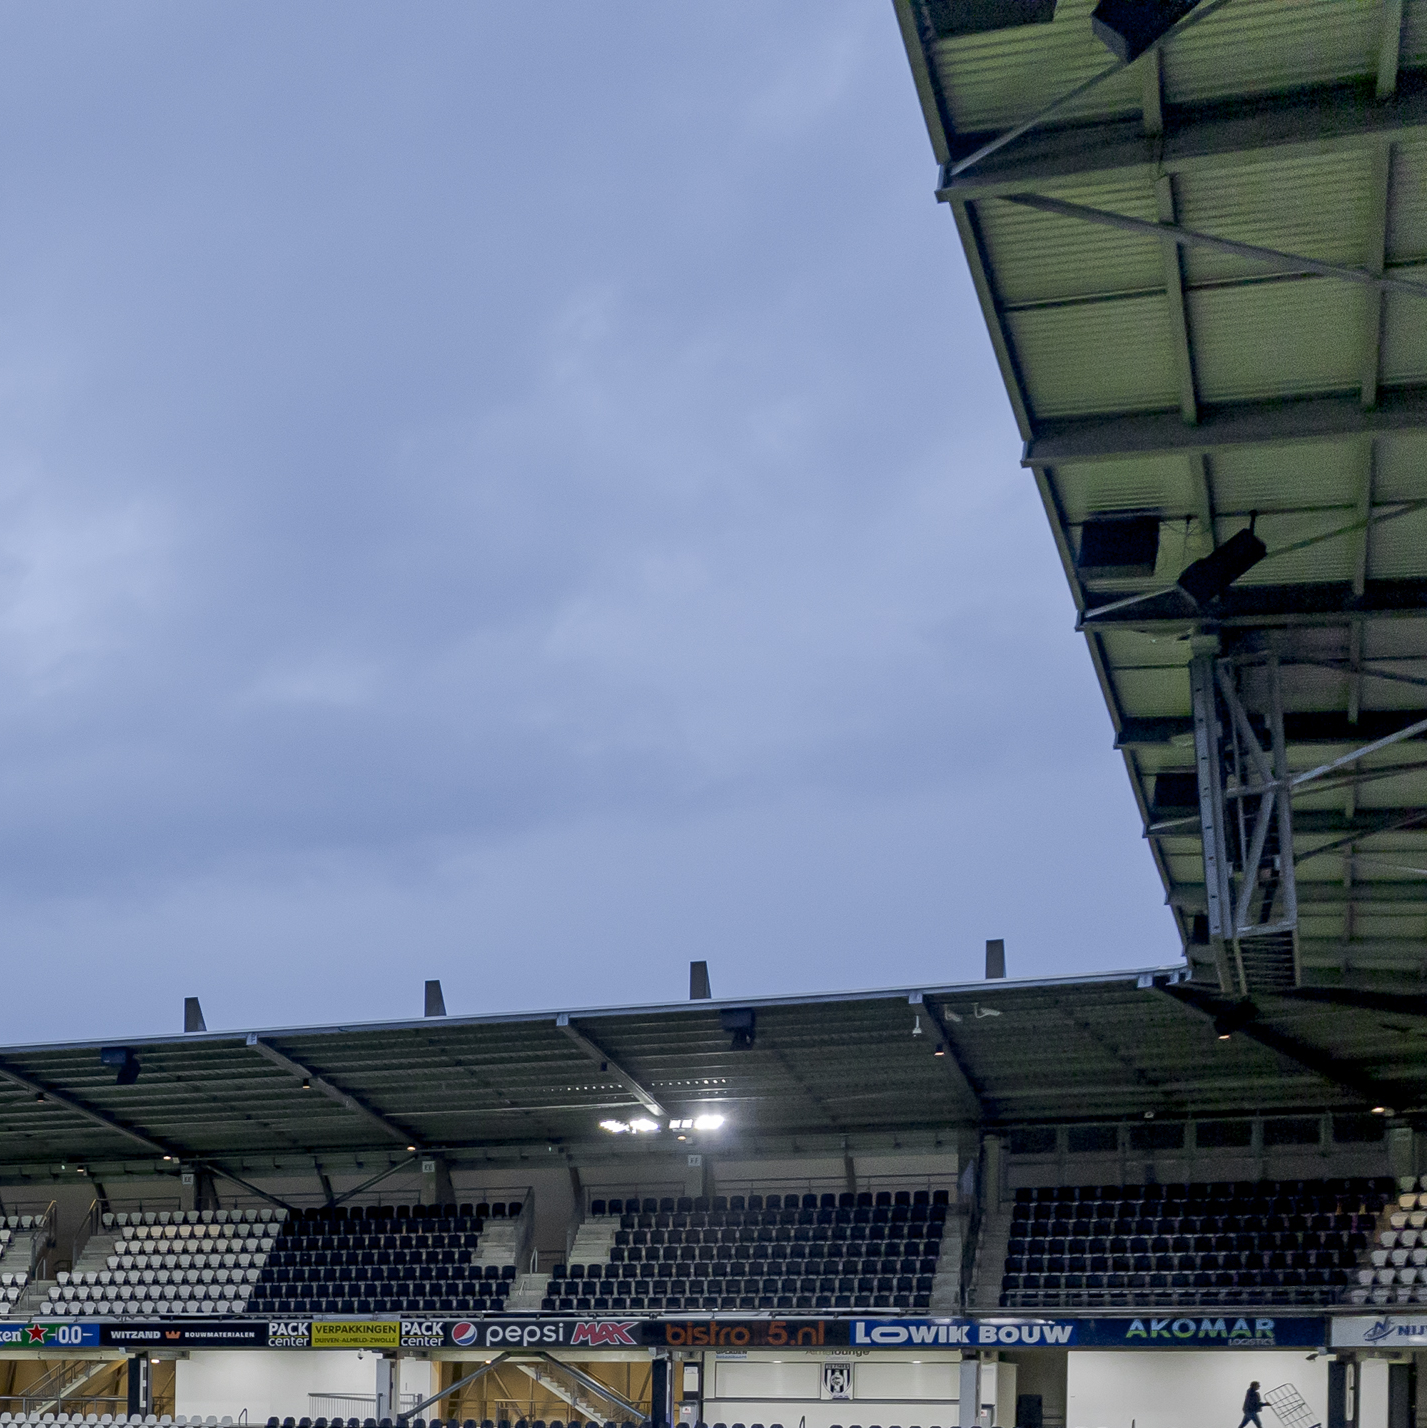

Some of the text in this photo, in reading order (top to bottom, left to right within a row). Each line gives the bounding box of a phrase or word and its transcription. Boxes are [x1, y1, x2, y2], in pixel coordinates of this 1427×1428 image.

[57, 1325, 82, 1344] 0.0
[110, 1330, 161, 1339] WITZAND
[268, 1322, 309, 1336] PACK
[315, 1325, 397, 1335] VERPAKKINGEN
[401, 1322, 444, 1336] PACK
[486, 1321, 639, 1347] pepsi MAX
[666, 1321, 750, 1346] bistro
[978, 1325, 1074, 1344] BOUW
[1125, 1318, 1276, 1339] AKOMAR
[1397, 1326, 1427, 1336] NIJ
[268, 1337, 309, 1347] center
[401, 1336, 444, 1347] center
